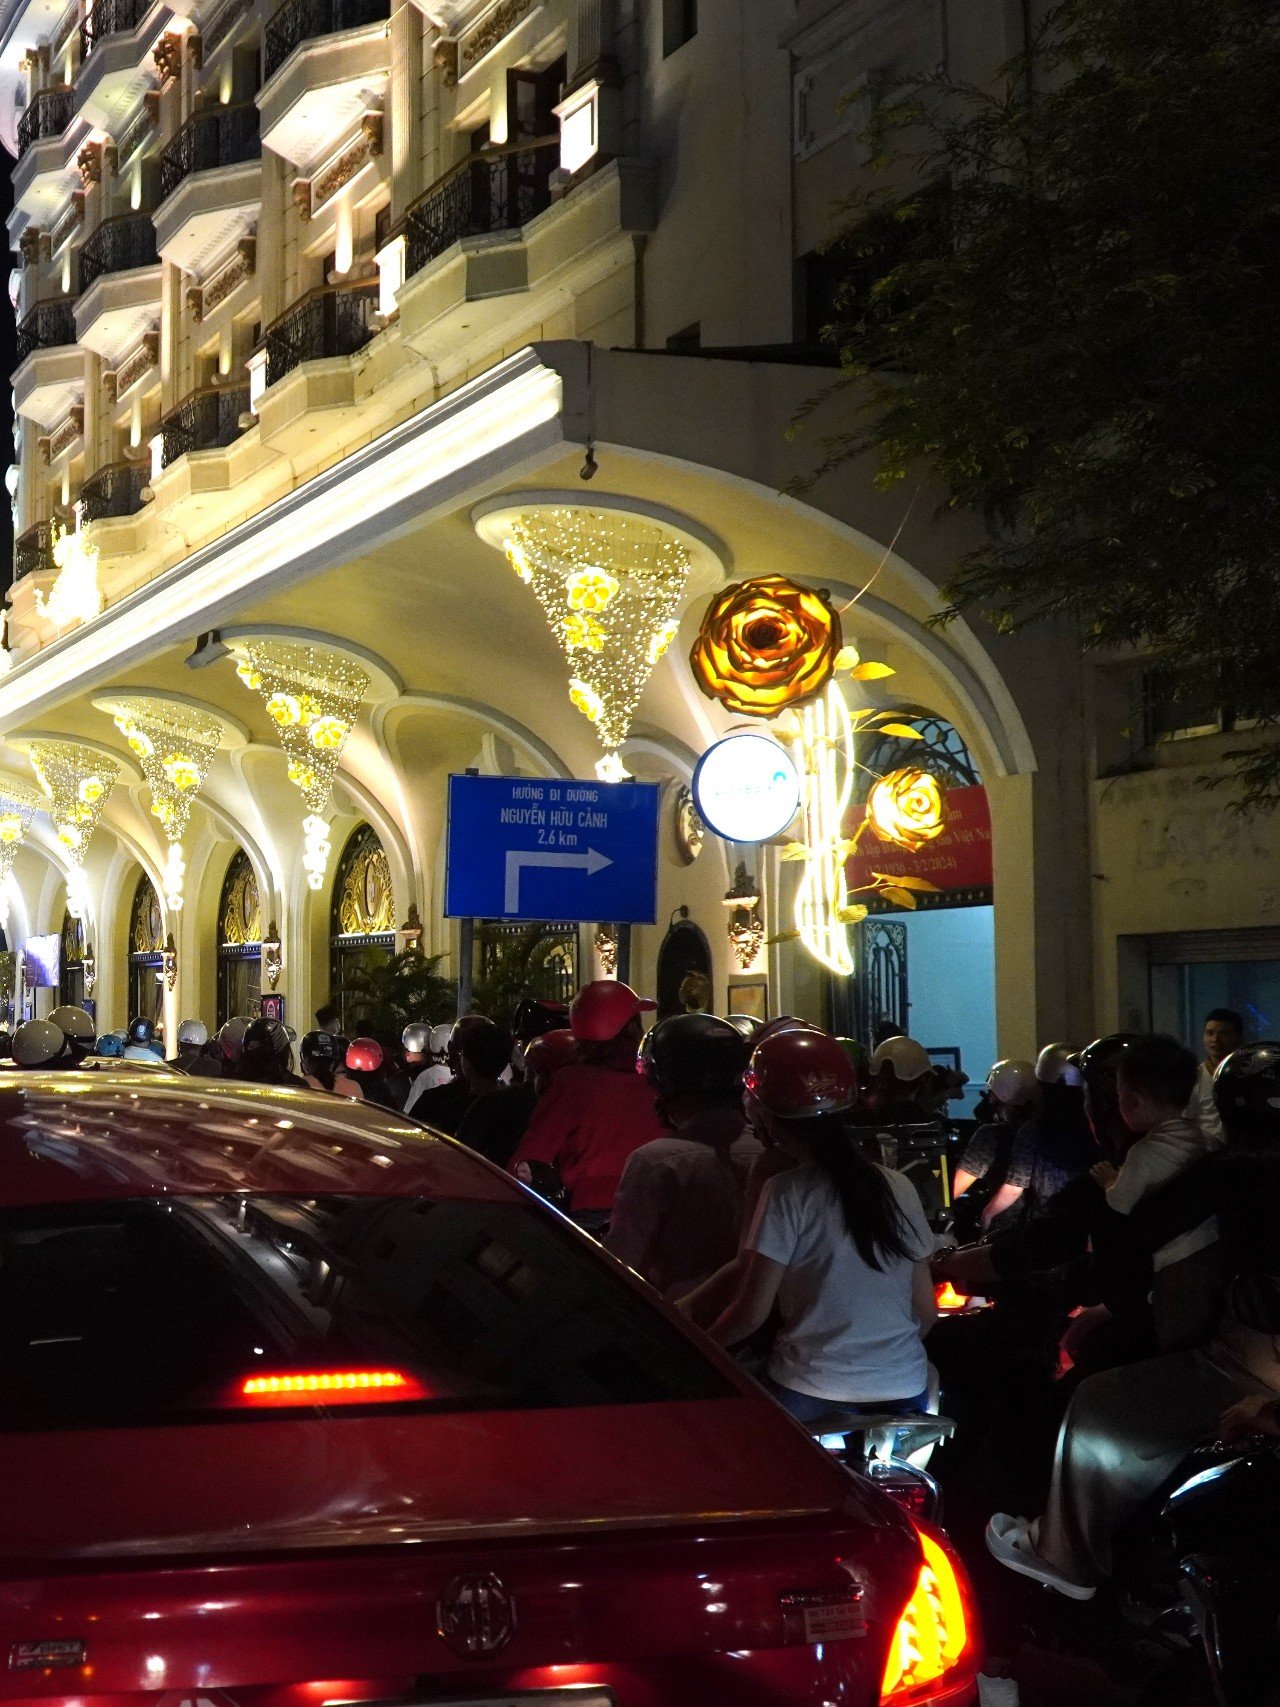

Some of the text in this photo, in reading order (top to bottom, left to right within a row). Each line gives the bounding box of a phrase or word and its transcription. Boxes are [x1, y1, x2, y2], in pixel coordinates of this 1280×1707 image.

[500, 803, 546, 826] NGUYỄN
[578, 806, 608, 828] CẢNH
[558, 830, 578, 846] km
